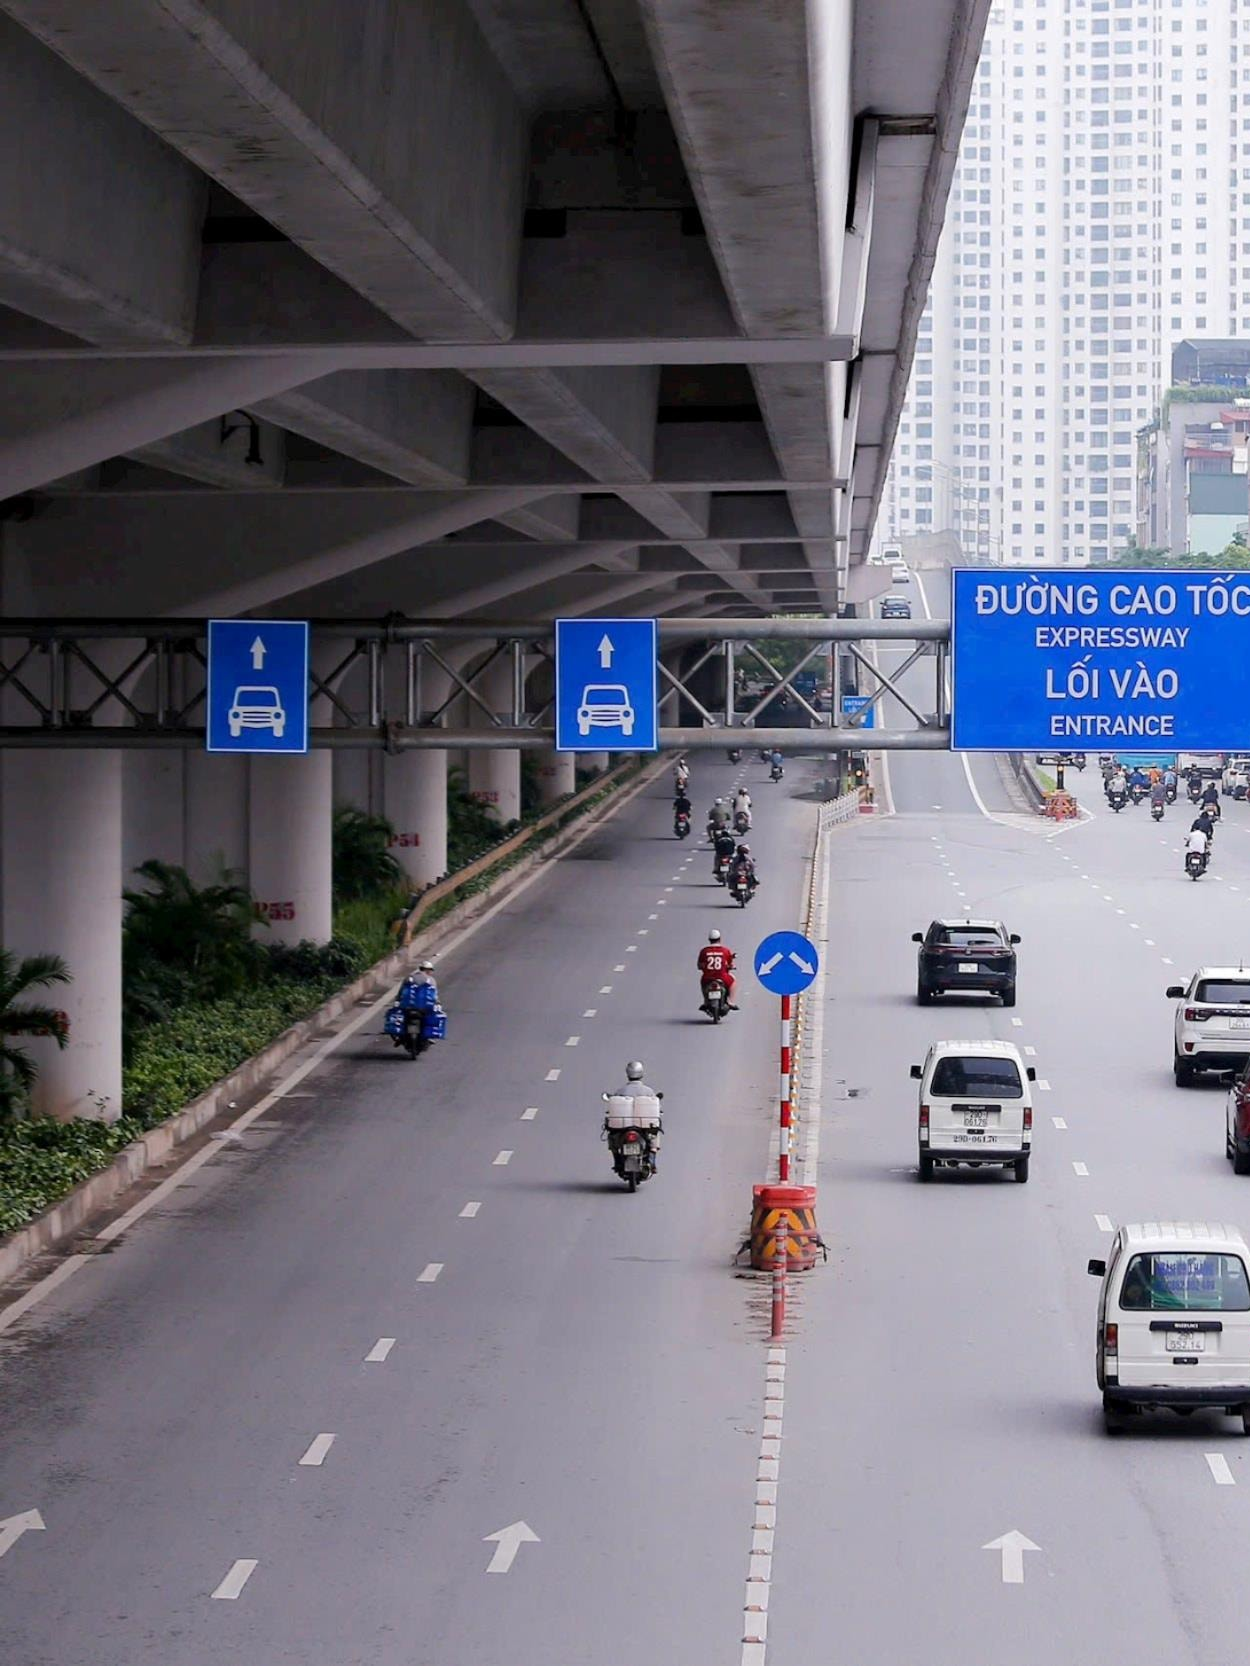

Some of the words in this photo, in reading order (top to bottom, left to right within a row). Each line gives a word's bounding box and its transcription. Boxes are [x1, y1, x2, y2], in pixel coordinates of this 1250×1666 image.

[975, 575, 1099, 616] ĐƯỜNG
[1109, 584, 1177, 616] CAO
[1035, 626, 1190, 648] EXPRESSWAY
[1045, 654, 1100, 700] LỐI
[1109, 661, 1179, 700] VÀO
[1050, 715, 1174, 737] ENTRANCE
[255, 902, 296, 921] P55
[707, 956, 722, 970] 28
